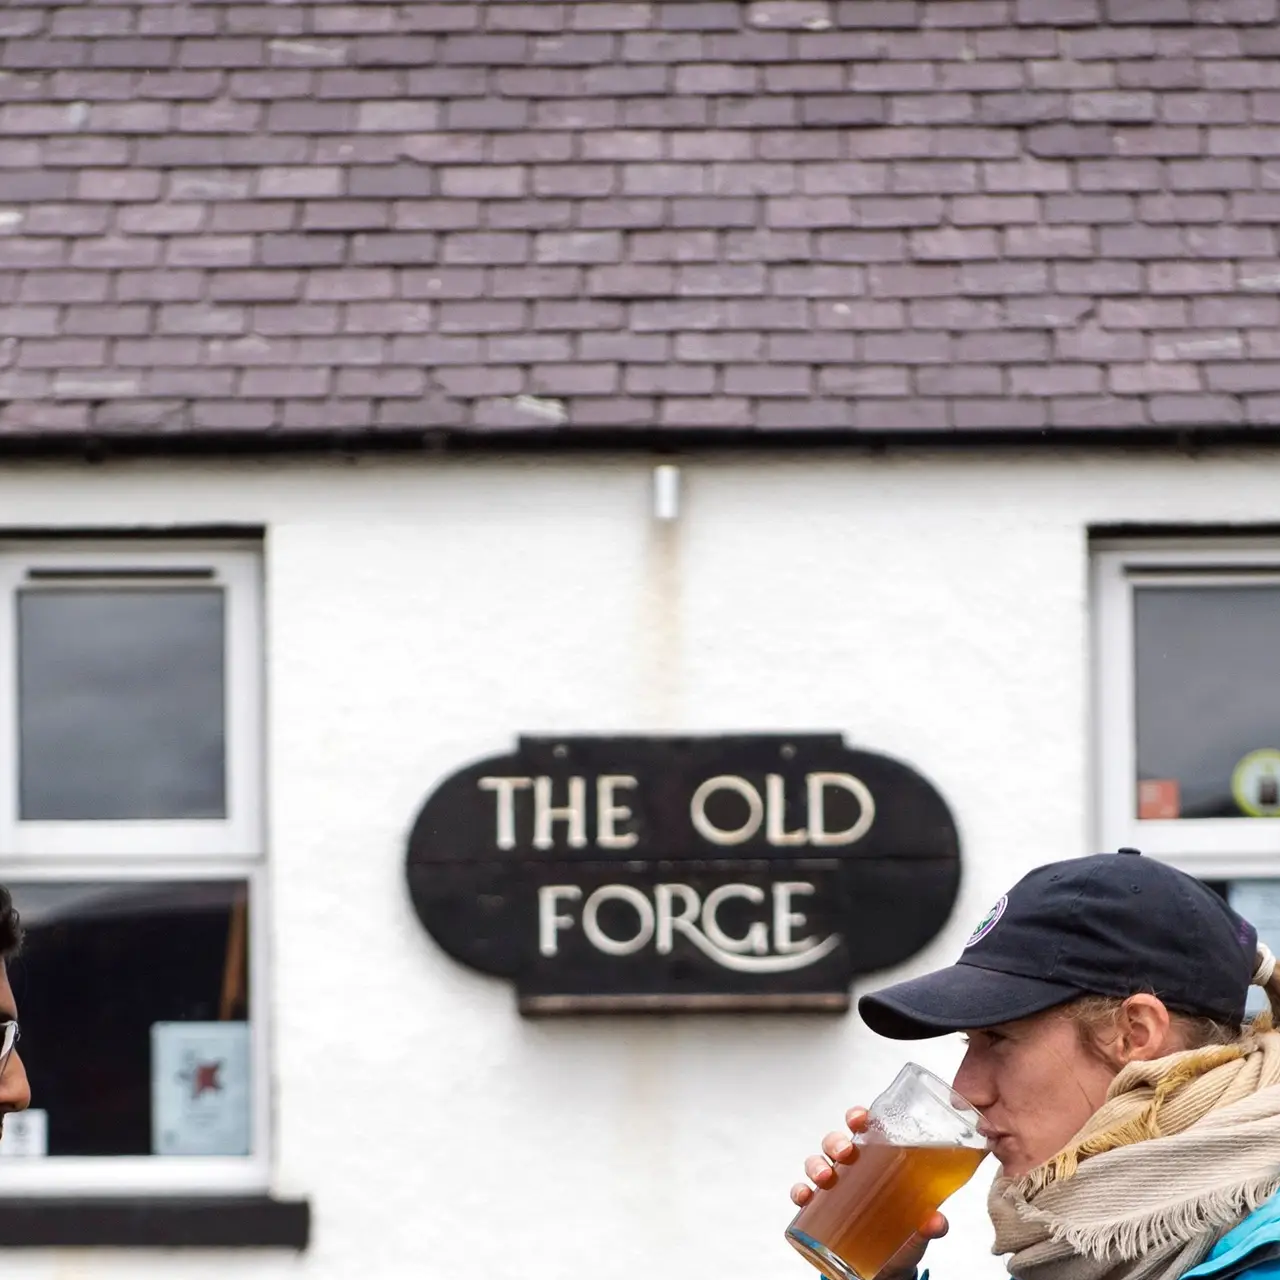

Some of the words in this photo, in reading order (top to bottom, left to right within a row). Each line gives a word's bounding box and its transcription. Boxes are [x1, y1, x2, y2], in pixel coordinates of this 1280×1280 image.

[478, 774, 639, 849] THE
[690, 772, 876, 847] OLD
[537, 881, 842, 973] FORGE
